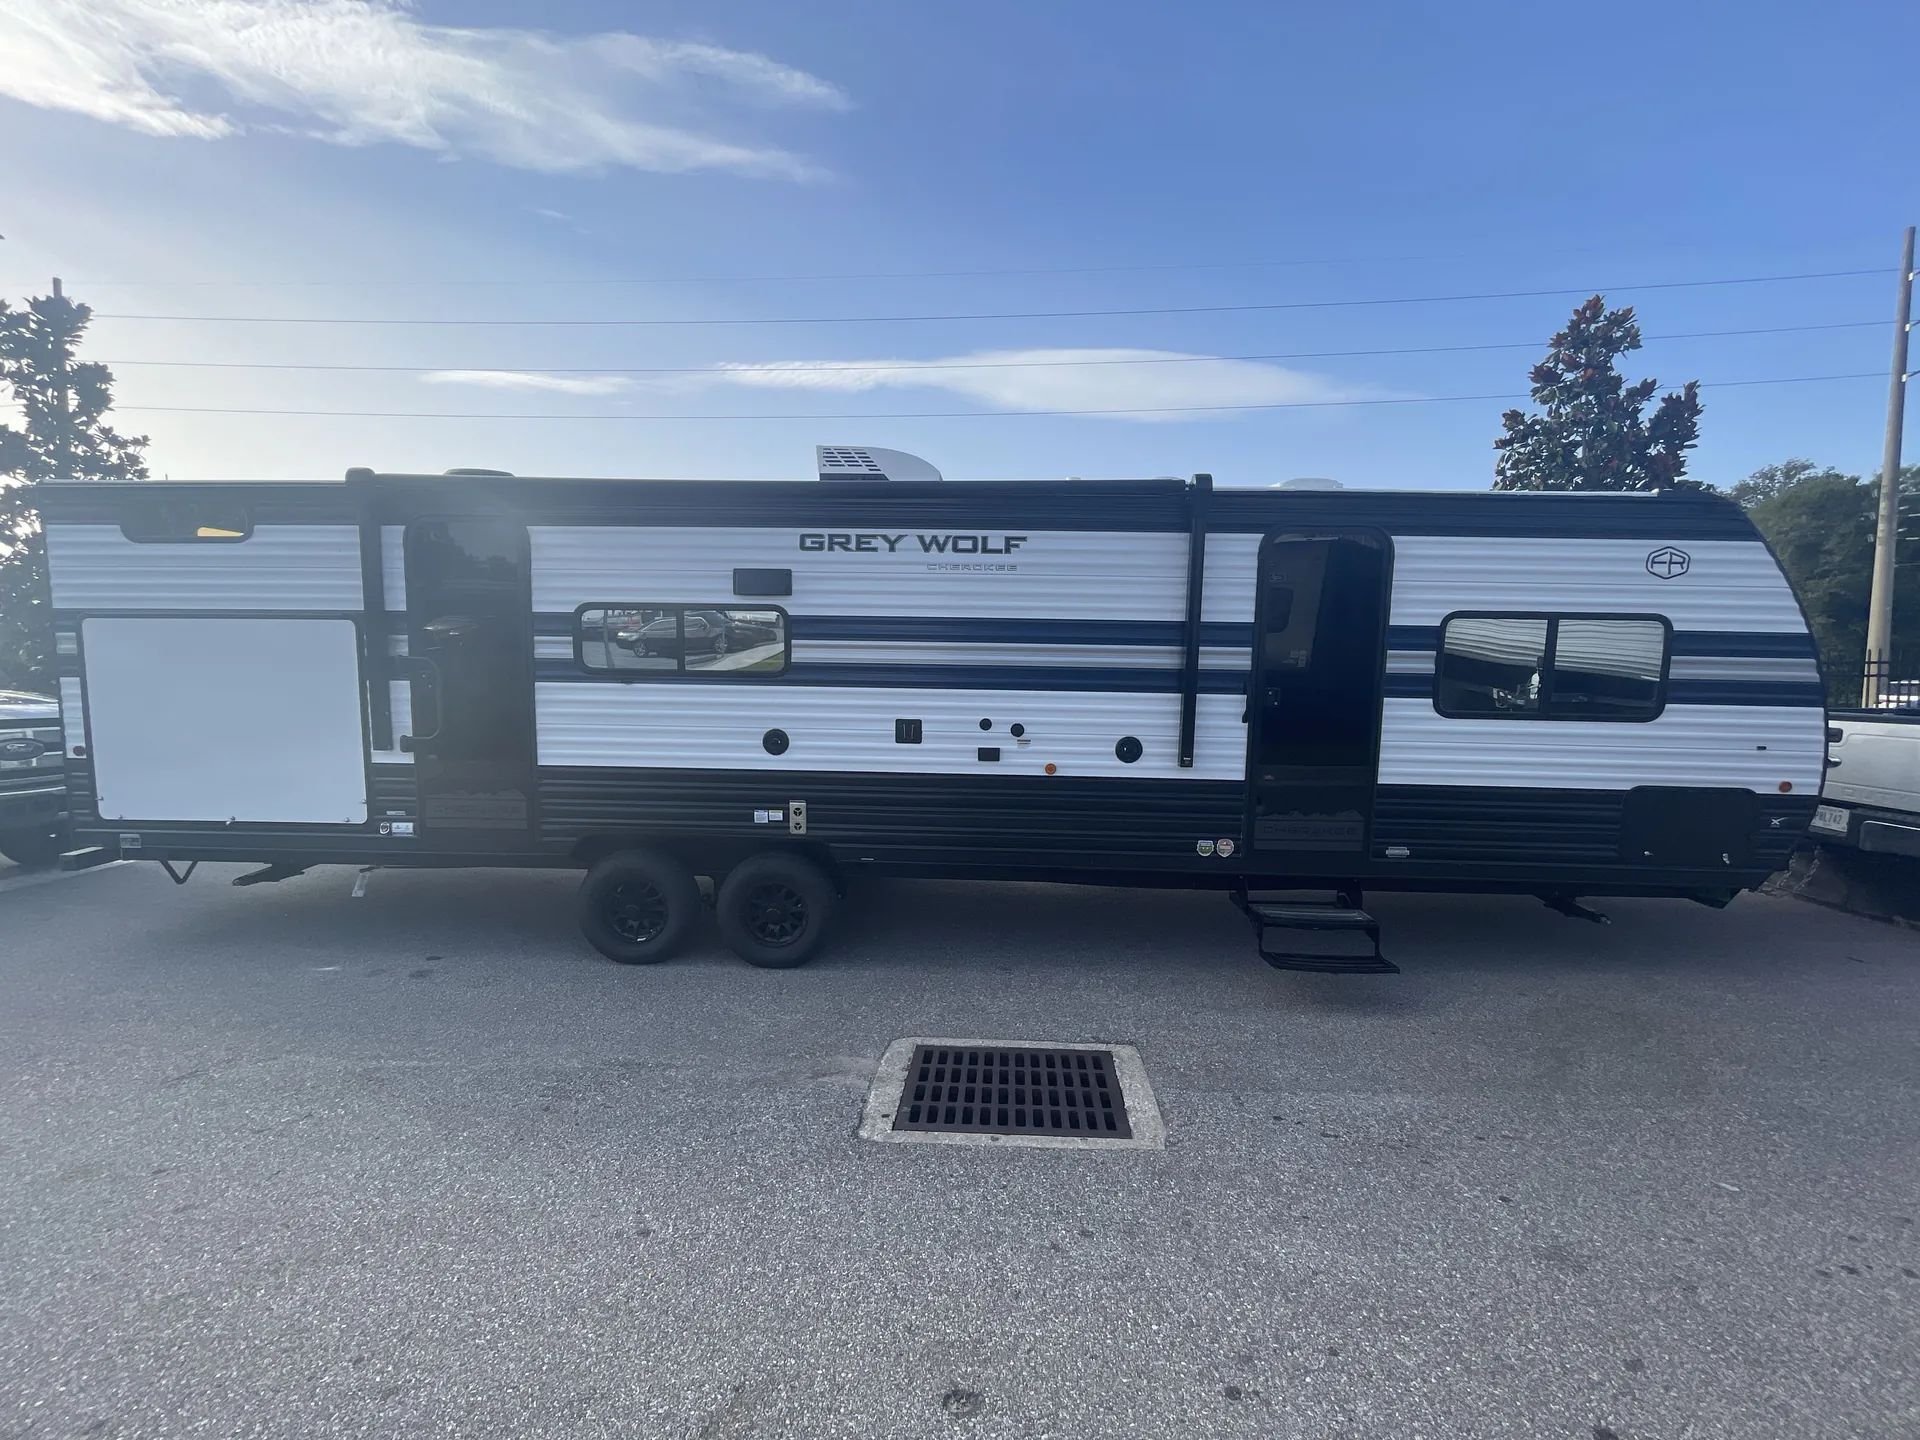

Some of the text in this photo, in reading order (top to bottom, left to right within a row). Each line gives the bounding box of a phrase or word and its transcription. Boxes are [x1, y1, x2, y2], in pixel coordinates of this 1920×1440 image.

[799, 533, 1028, 554] GREY WOLF
[926, 563, 1018, 572] CHEROKEE
